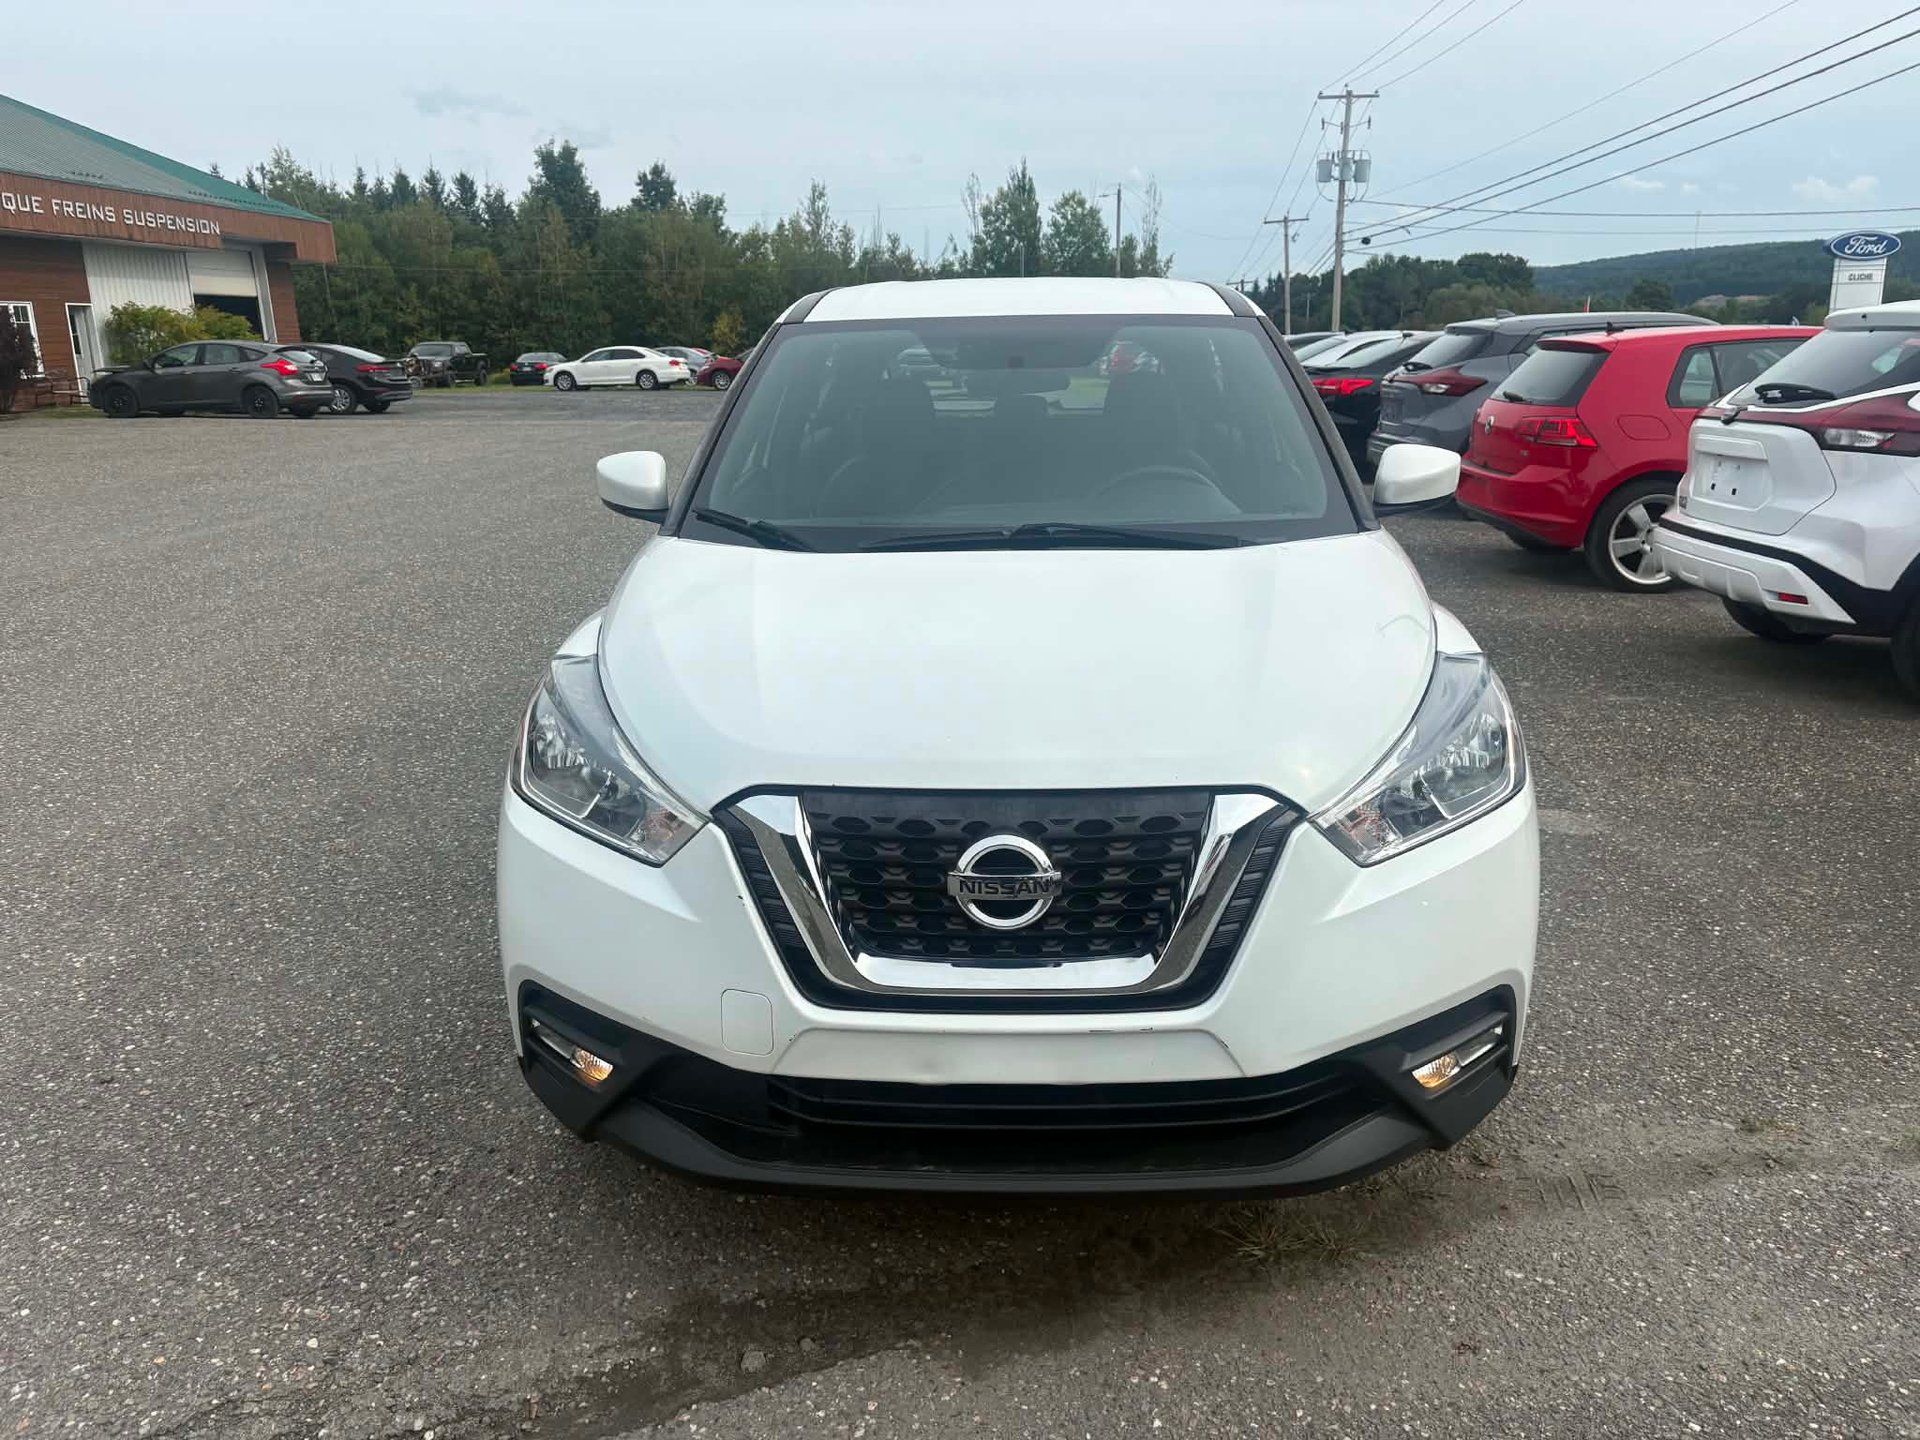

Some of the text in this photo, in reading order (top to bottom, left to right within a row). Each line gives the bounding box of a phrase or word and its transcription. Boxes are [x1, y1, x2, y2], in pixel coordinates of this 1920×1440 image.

[1, 191, 221, 235] QUE FREINS SUSPENSION
[1844, 235, 1889, 254] Ford
[958, 878, 1050, 895] NISSAN
